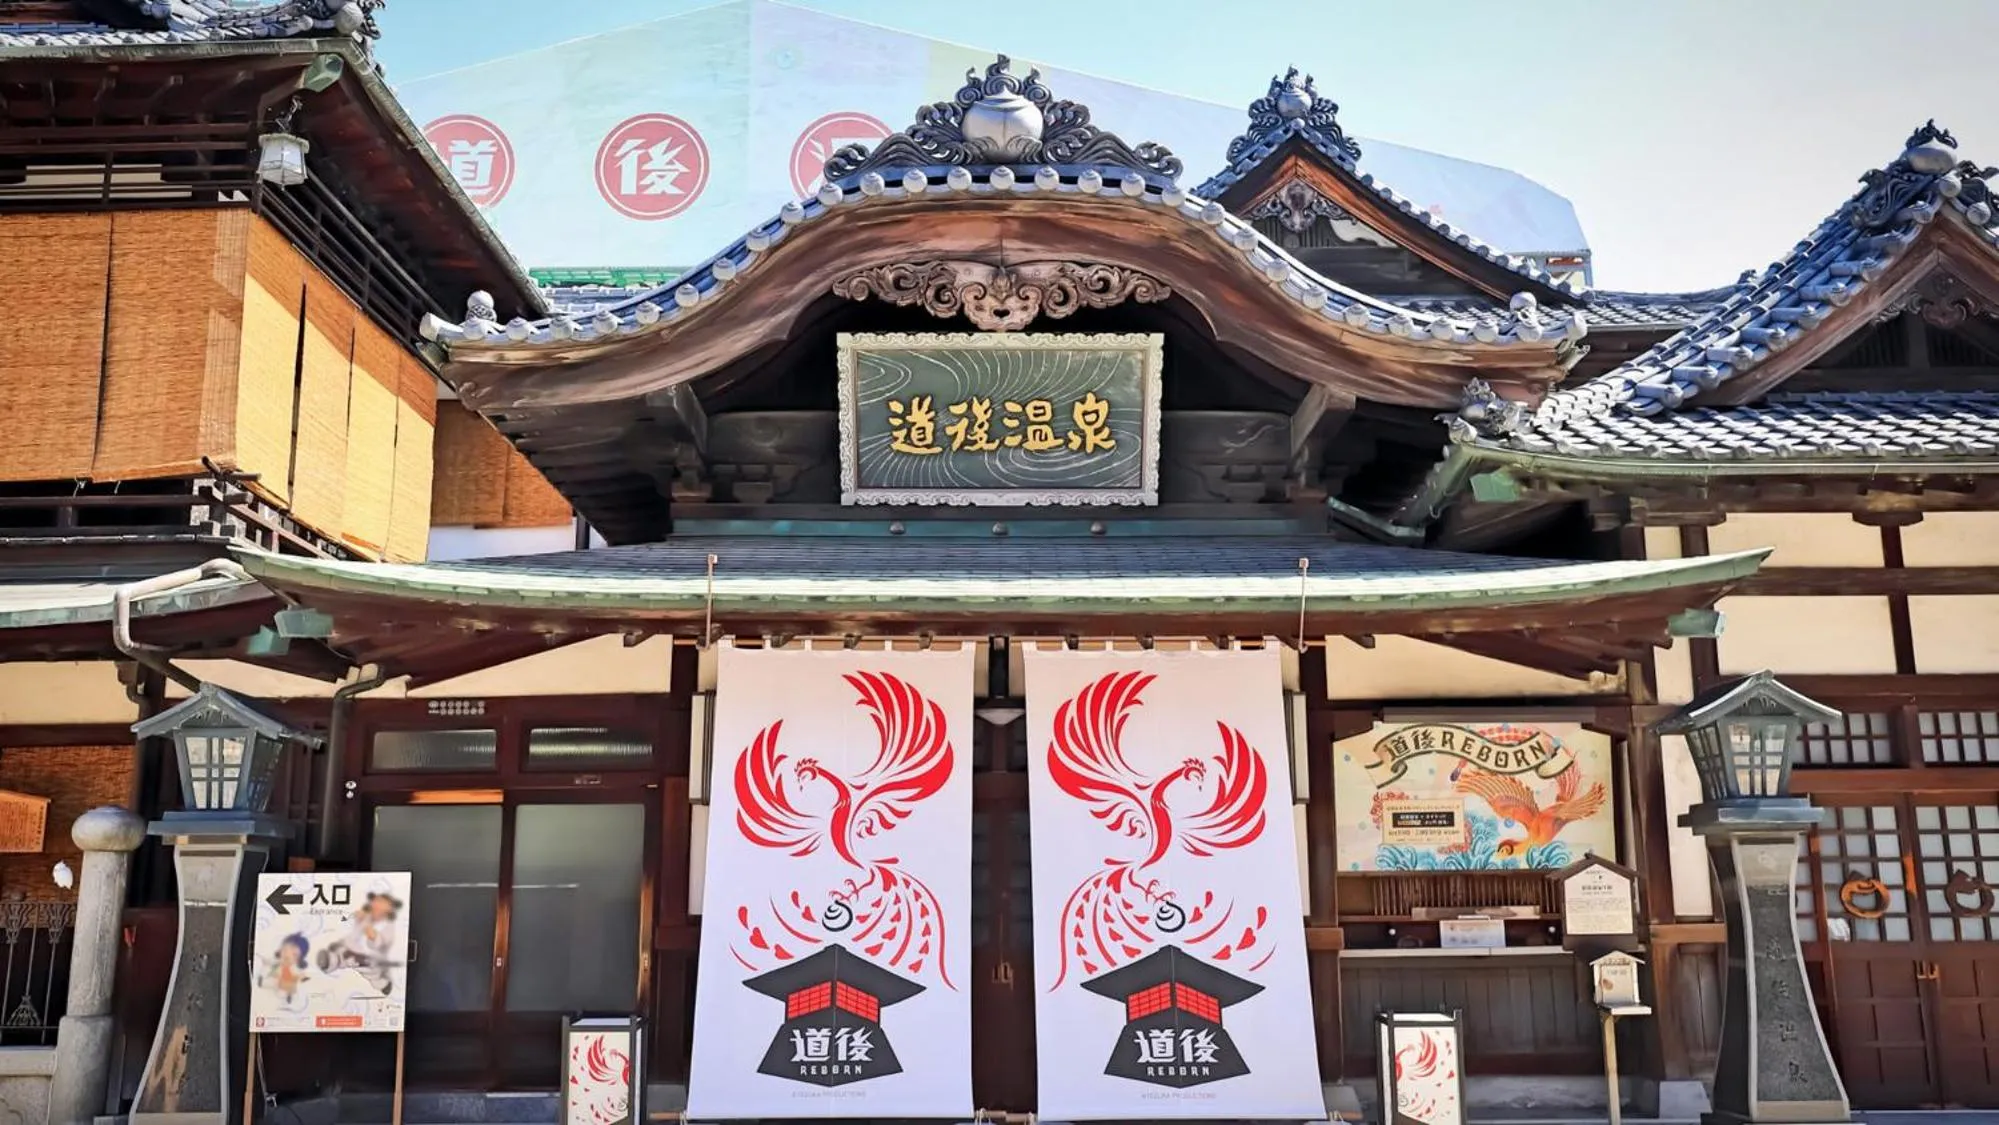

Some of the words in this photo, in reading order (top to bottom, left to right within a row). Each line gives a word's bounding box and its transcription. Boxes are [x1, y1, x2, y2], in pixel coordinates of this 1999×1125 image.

[612, 137, 690, 196] 後
[888, 391, 1116, 455] 道後温泉
[1388, 728, 1435, 760] 道後
[1441, 731, 1551, 768] REBORN
[310, 884, 351, 905] 入口
[790, 1027, 875, 1062] 道後
[1134, 1028, 1220, 1063] 道後
[800, 1065, 862, 1076] REBORN
[1147, 1066, 1210, 1076] REBORN
